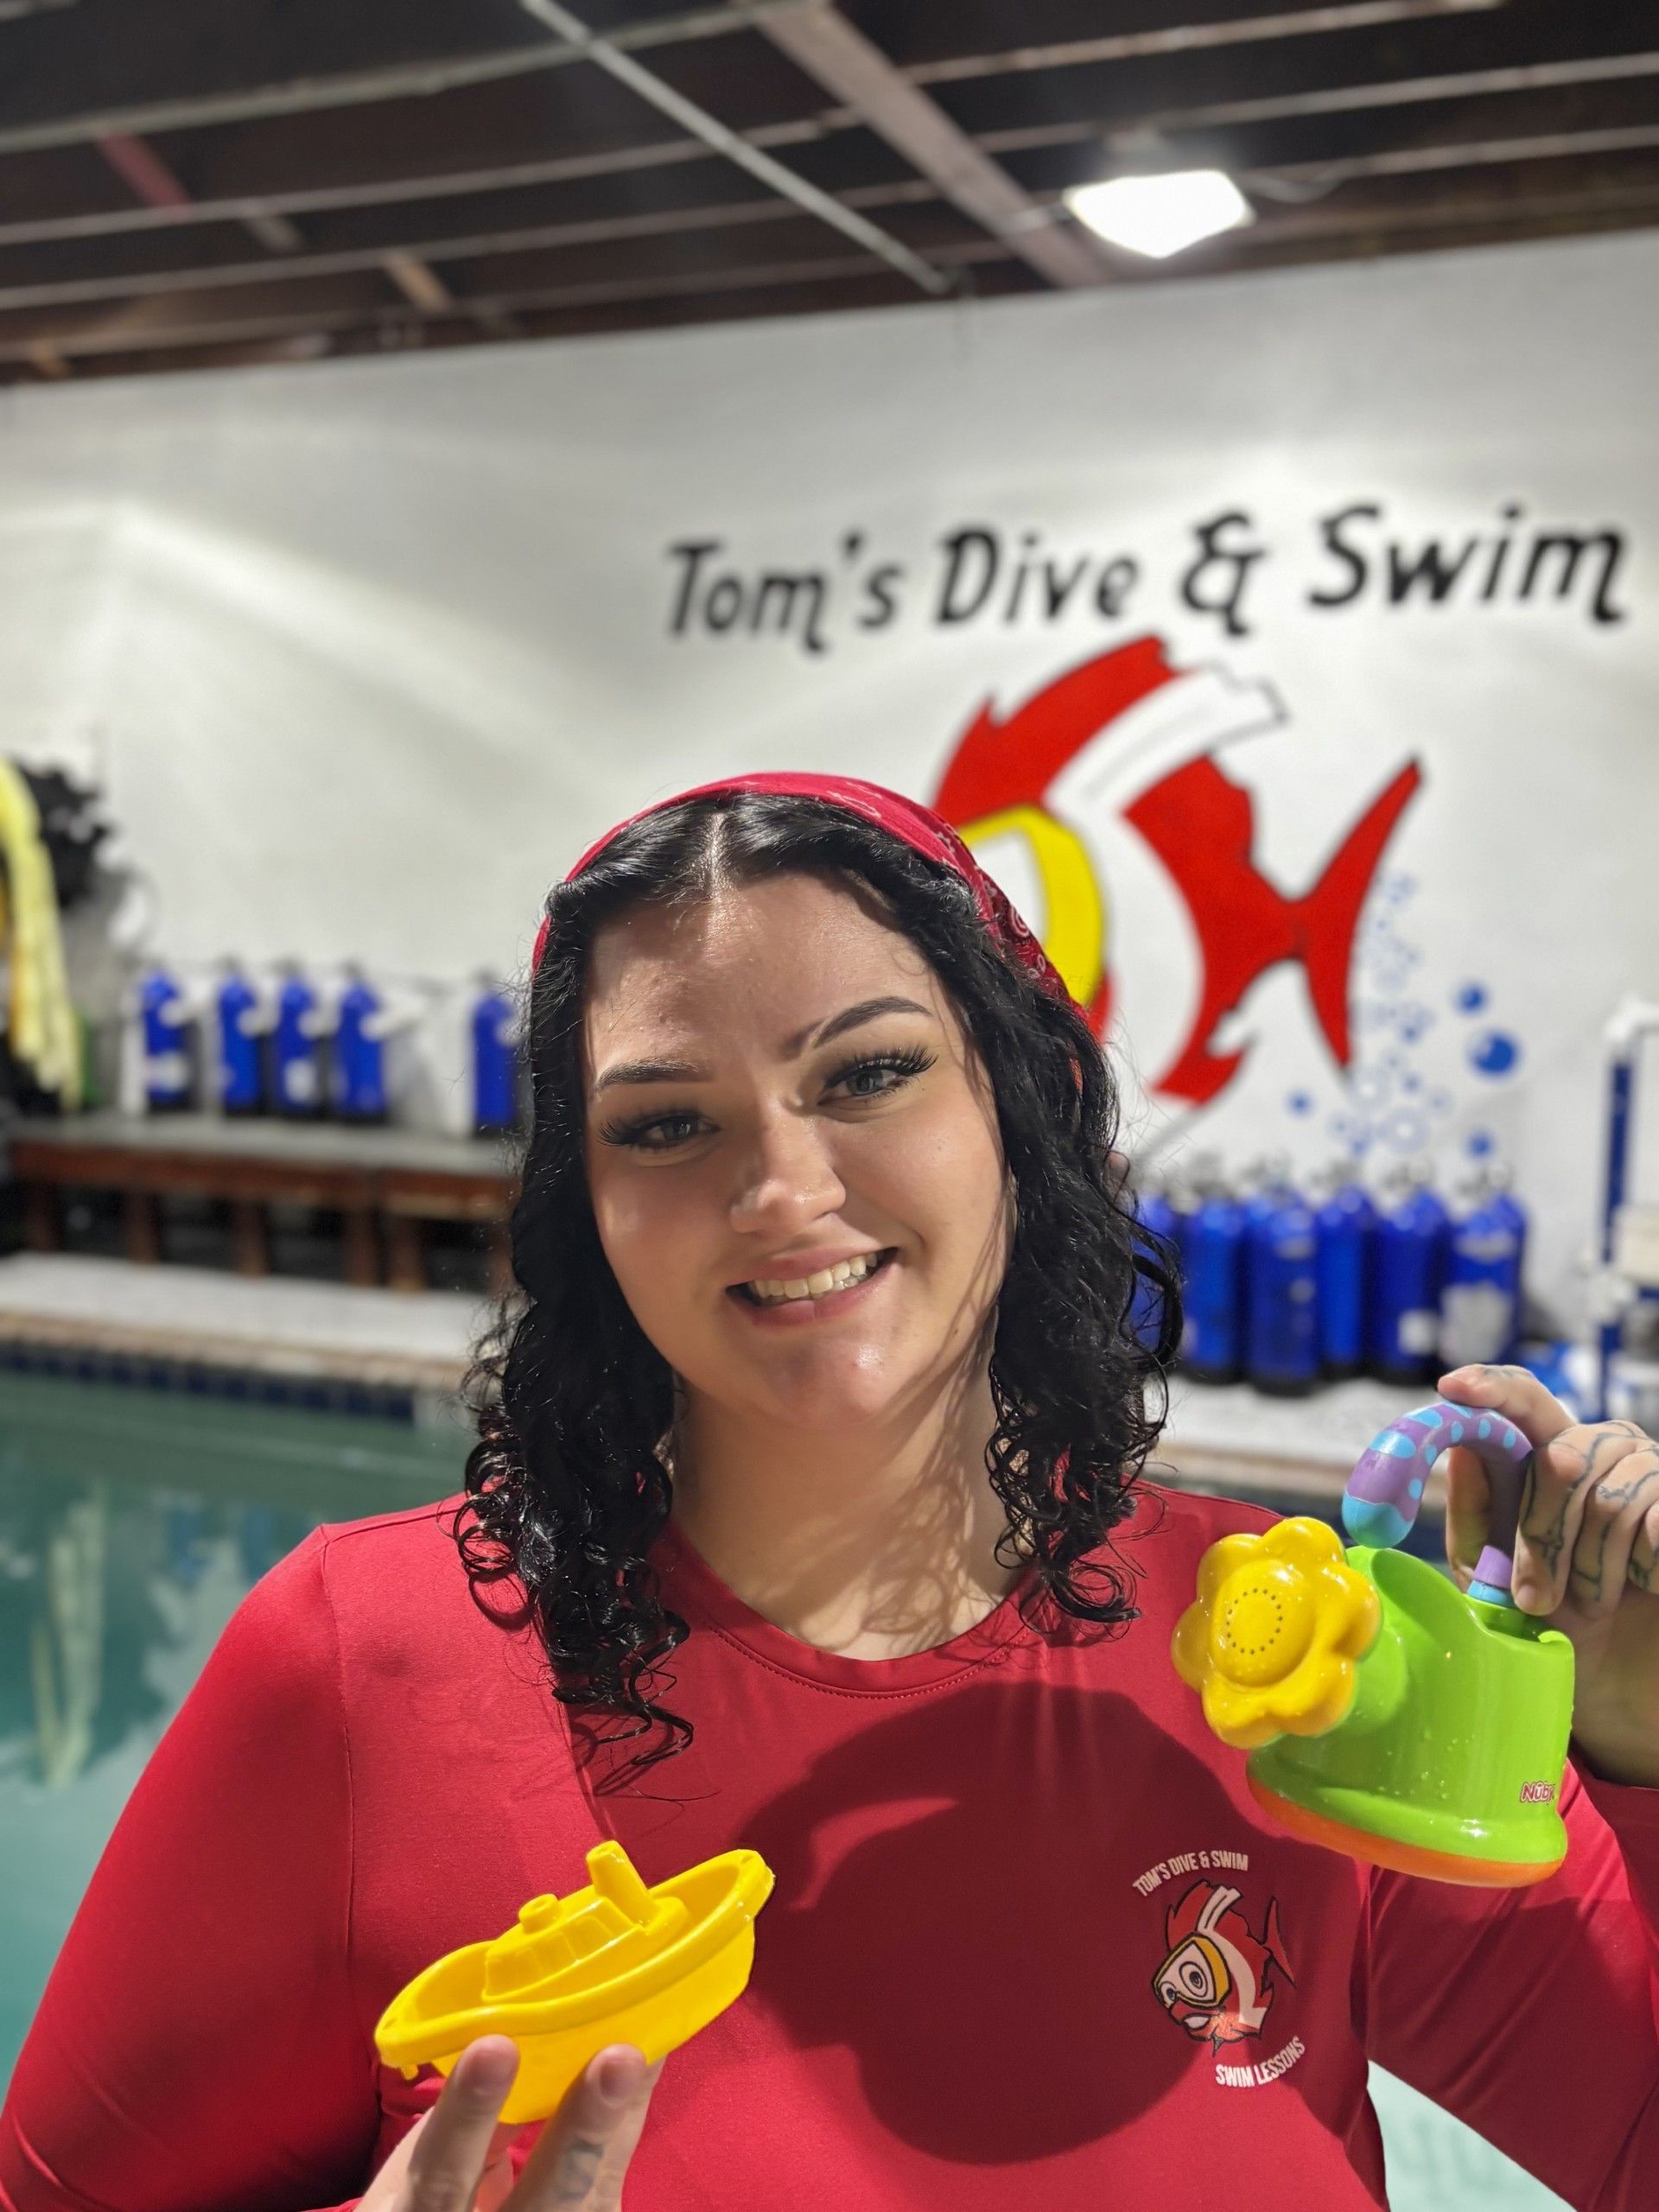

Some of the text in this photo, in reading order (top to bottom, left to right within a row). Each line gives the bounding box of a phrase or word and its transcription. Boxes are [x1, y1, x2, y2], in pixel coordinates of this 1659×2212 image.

[667, 503, 1627, 653] Tom's Dive & Swim
[1132, 1850, 1249, 1897] TOM'S DIVE & SWIM
[1216, 2036, 1306, 2087] SWIM LESSONS
